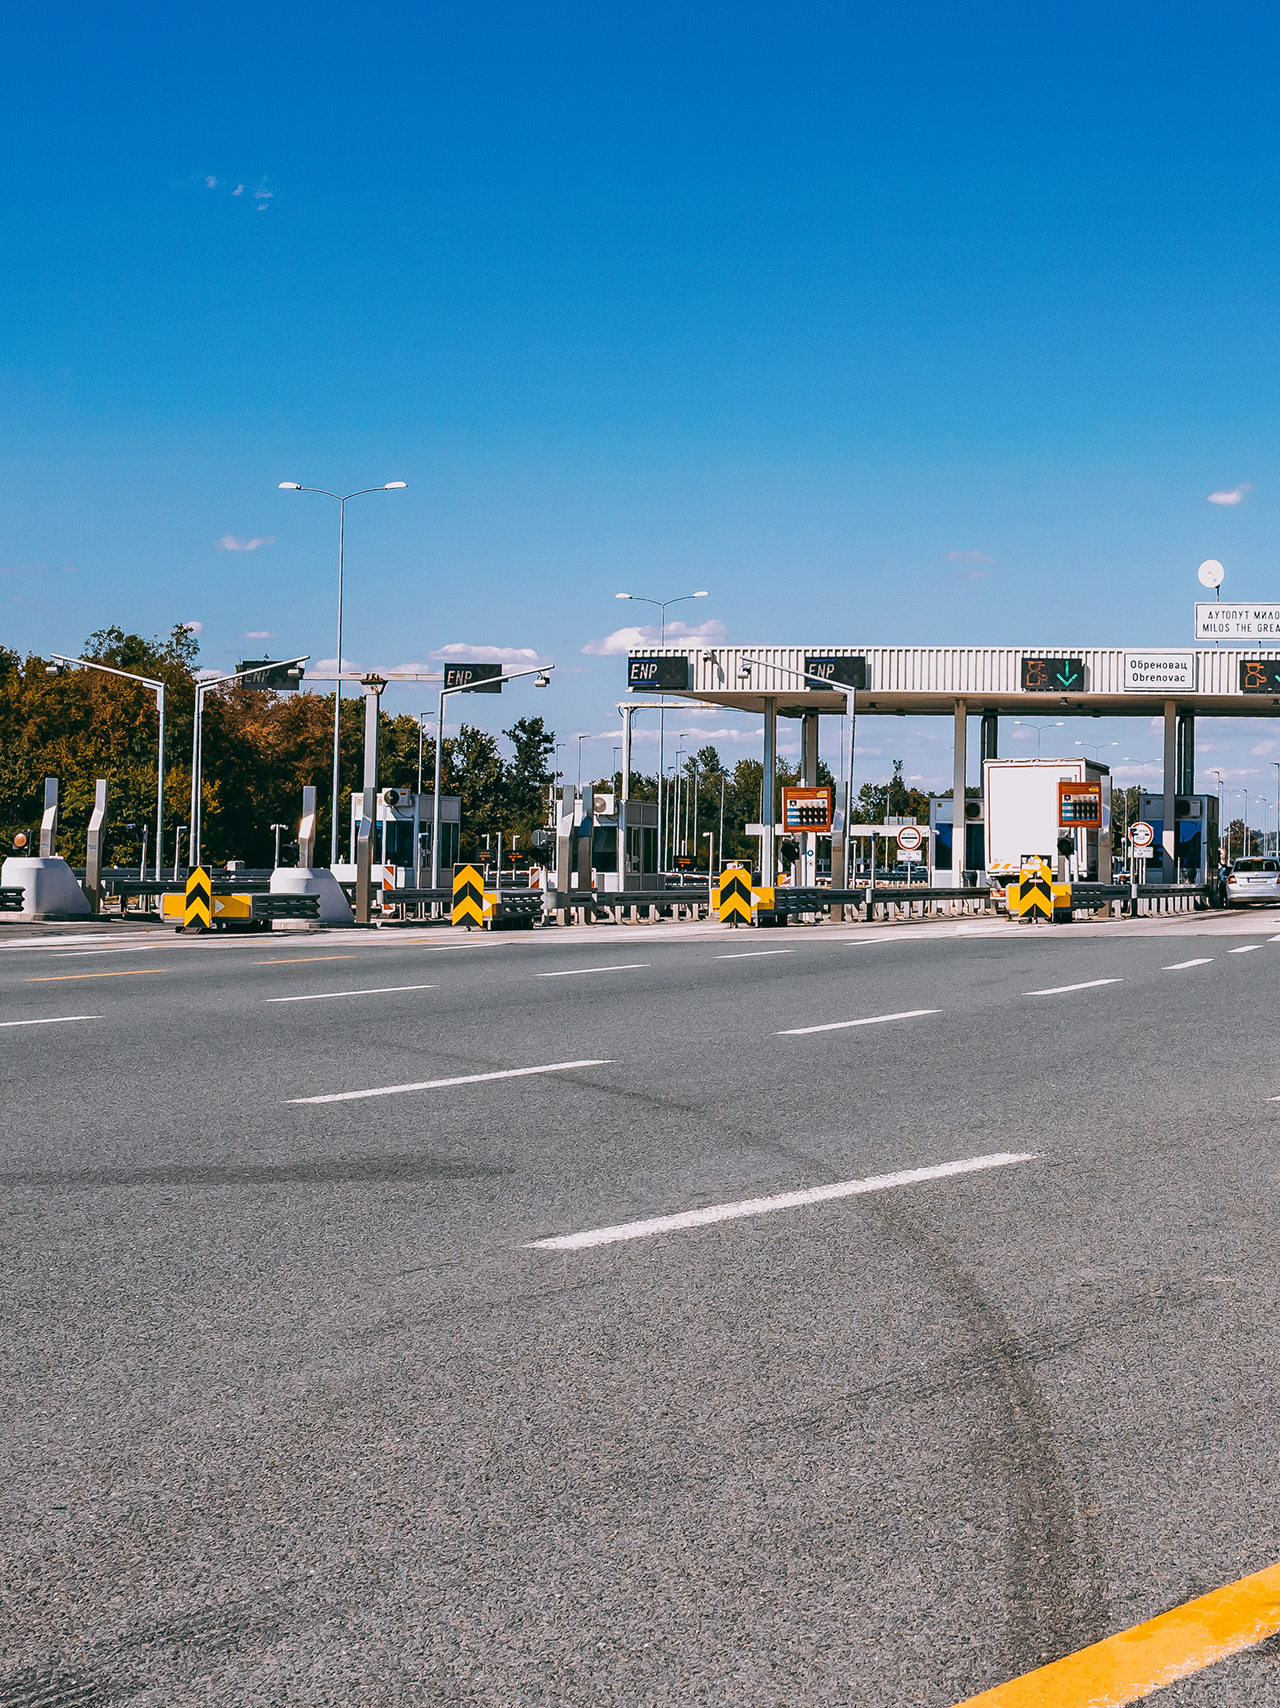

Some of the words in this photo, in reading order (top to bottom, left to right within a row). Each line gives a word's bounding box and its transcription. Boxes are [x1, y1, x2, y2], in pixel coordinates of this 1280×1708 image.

[1207, 610, 1249, 620] АУТОПУТ
[1202, 623, 1230, 633] MILOS
[1235, 623, 1252, 633] THE
[1130, 659, 1188, 671] Обреновац
[630, 663, 658, 680] ENP
[1132, 672, 1186, 682] Obrenovac
[446, 670, 473, 686] ENP
